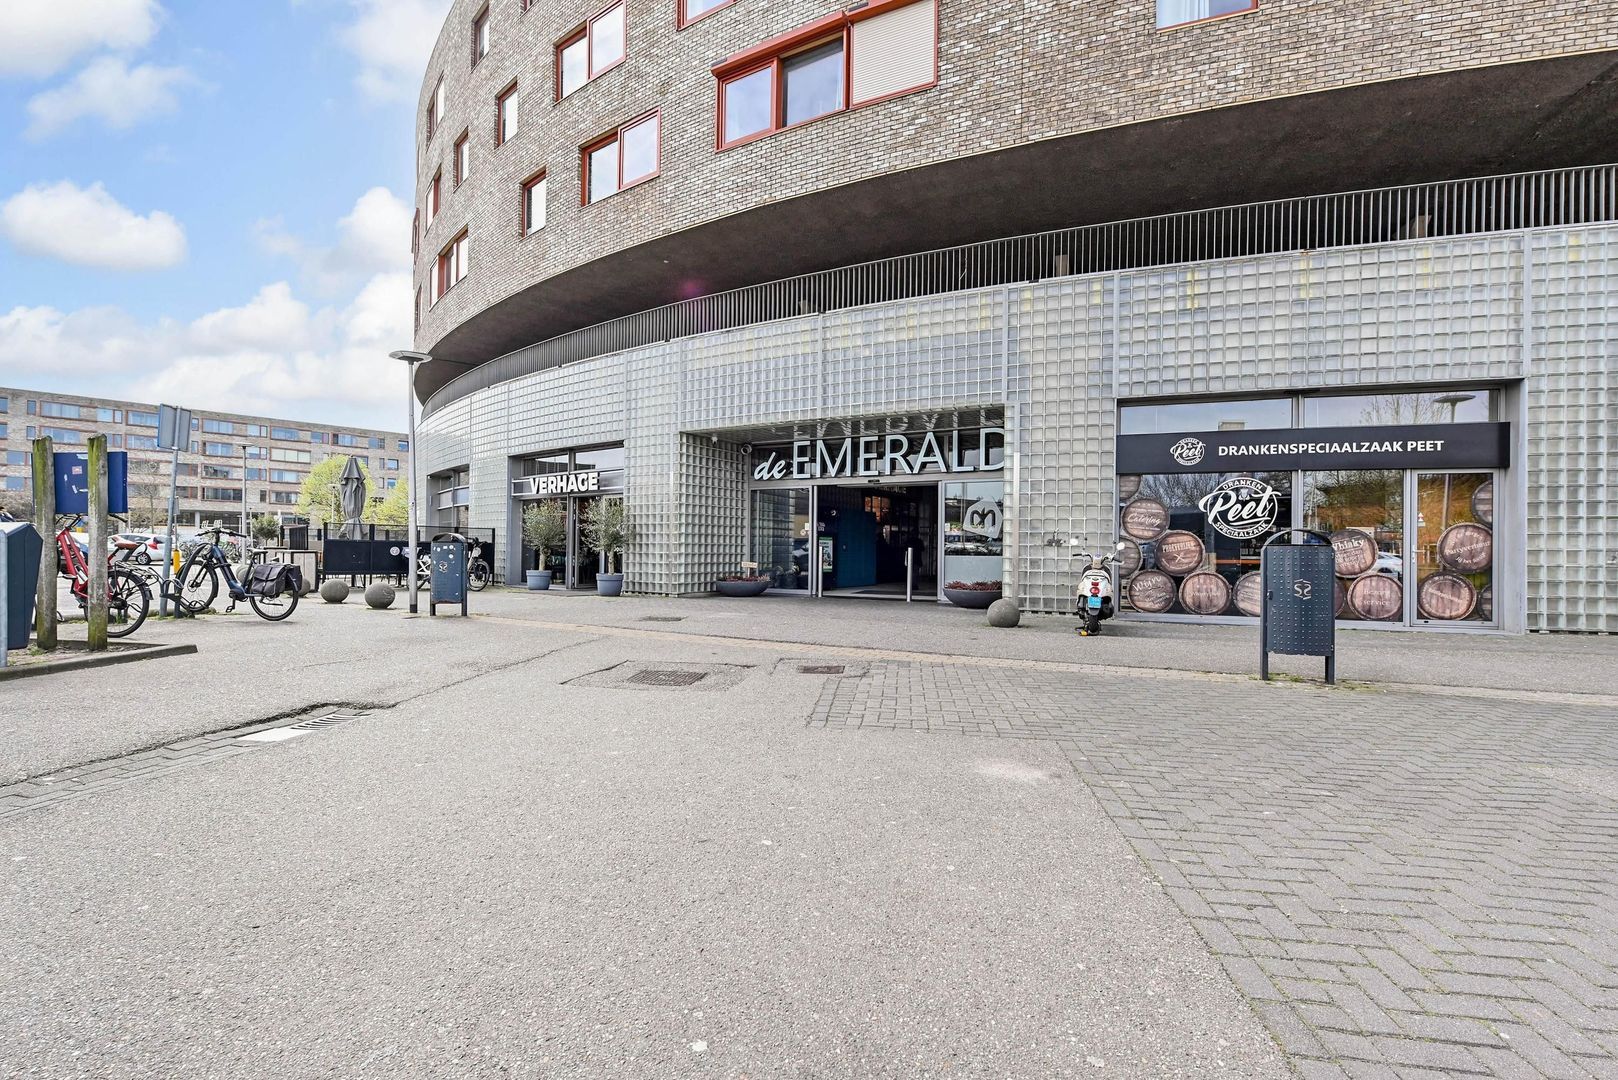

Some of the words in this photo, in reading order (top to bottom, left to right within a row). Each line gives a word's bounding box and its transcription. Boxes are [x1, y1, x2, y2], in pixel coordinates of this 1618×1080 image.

[753, 451, 786, 480] de
[793, 427, 1005, 479] EMERALD
[1218, 441, 1403, 456] DRANKENSPECIAALZAAK
[1407, 440, 1444, 451] PEET
[529, 472, 598, 495] VERHAGE
[1222, 479, 1263, 490] DRANKEN
[1198, 485, 1282, 525] Peet
[1215, 521, 1269, 538] SPECIAALZAAK
